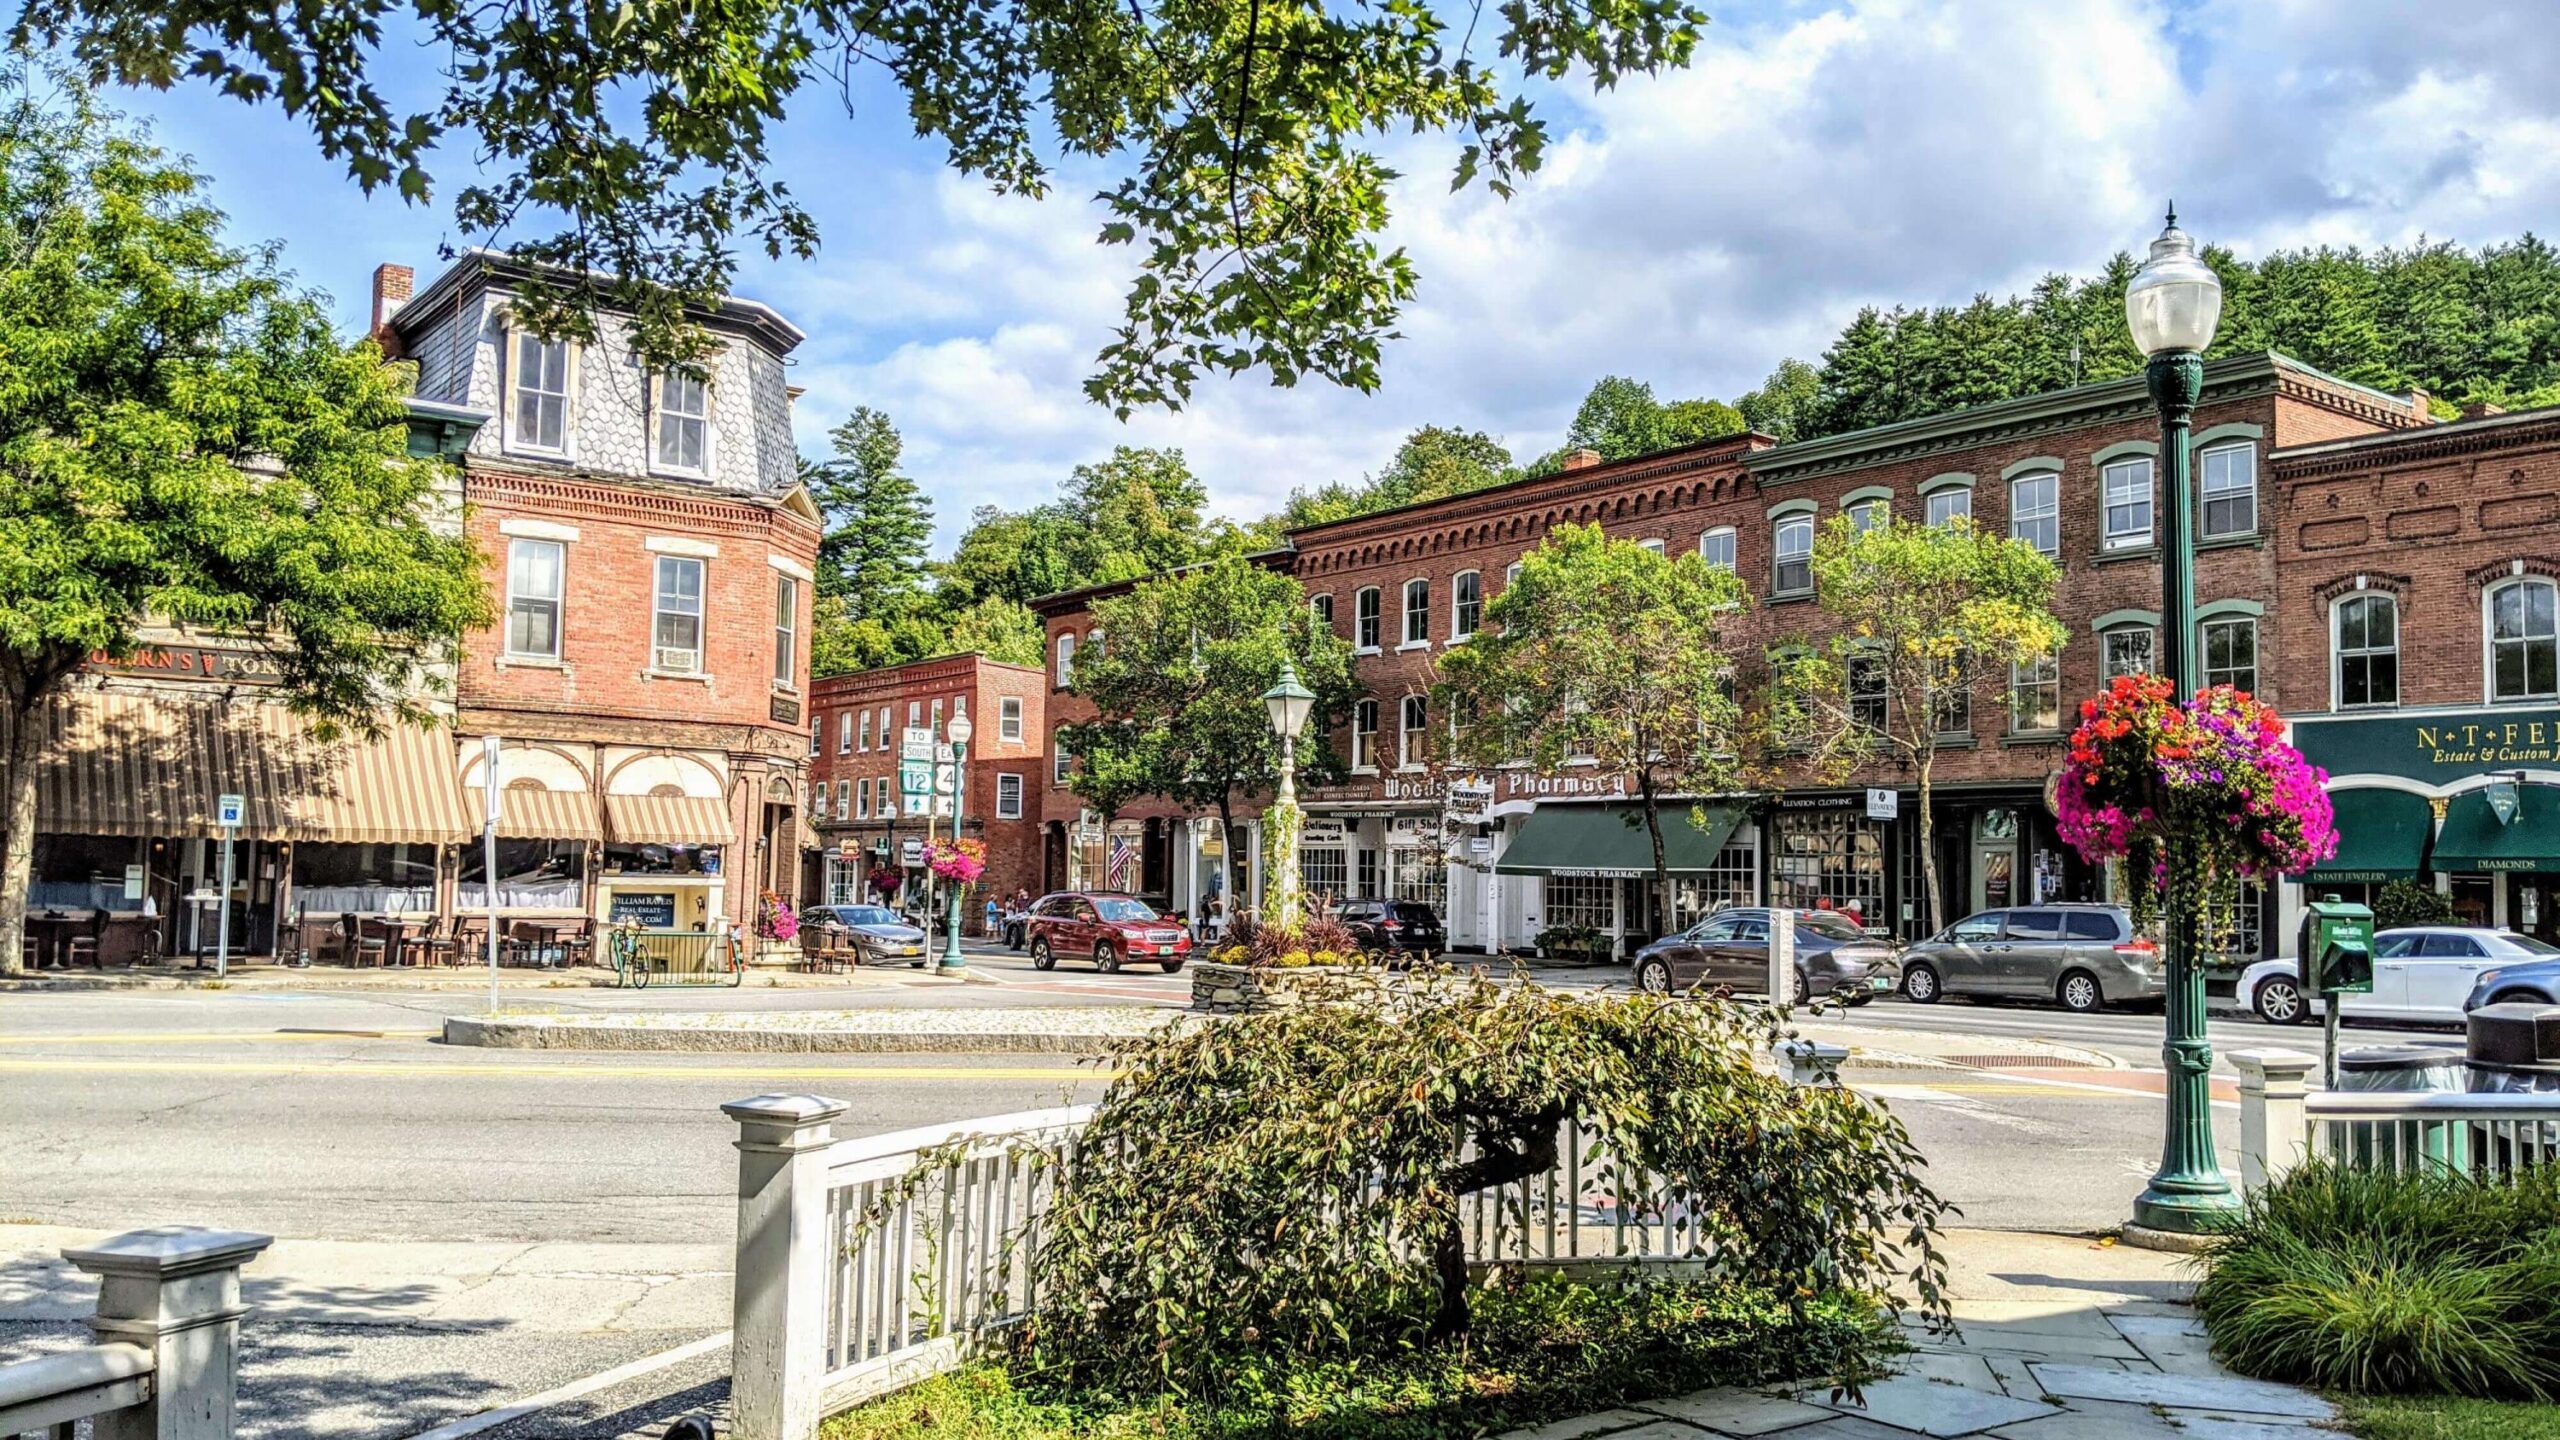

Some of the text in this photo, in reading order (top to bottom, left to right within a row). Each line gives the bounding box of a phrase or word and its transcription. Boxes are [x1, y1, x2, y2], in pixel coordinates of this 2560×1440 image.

[80, 648, 193, 672] ORN'S
[911, 732, 925, 740] TO
[907, 746, 931, 758] SOUTH
[941, 749, 955, 758] EA
[2432, 749, 2476, 763] Estate
[2480, 747, 2495, 761] &
[2499, 747, 2550, 761] Custom
[908, 773, 927, 790] 12
[943, 770, 955, 787] 4
[1508, 773, 1625, 796] Pharmacy
[1782, 798, 1852, 808] ELEVATION CLOTHING
[1868, 803, 1896, 811] ELEVATION
[1420, 819, 1438, 830] Sho
[2477, 860, 2536, 869] DIAMONDS
[1551, 869, 1642, 878] WOODSTOCK PHARMACY
[2313, 872, 2342, 881] ESTATE
[610, 896, 645, 905] WILLIAM
[620, 906, 636, 914] REAL
